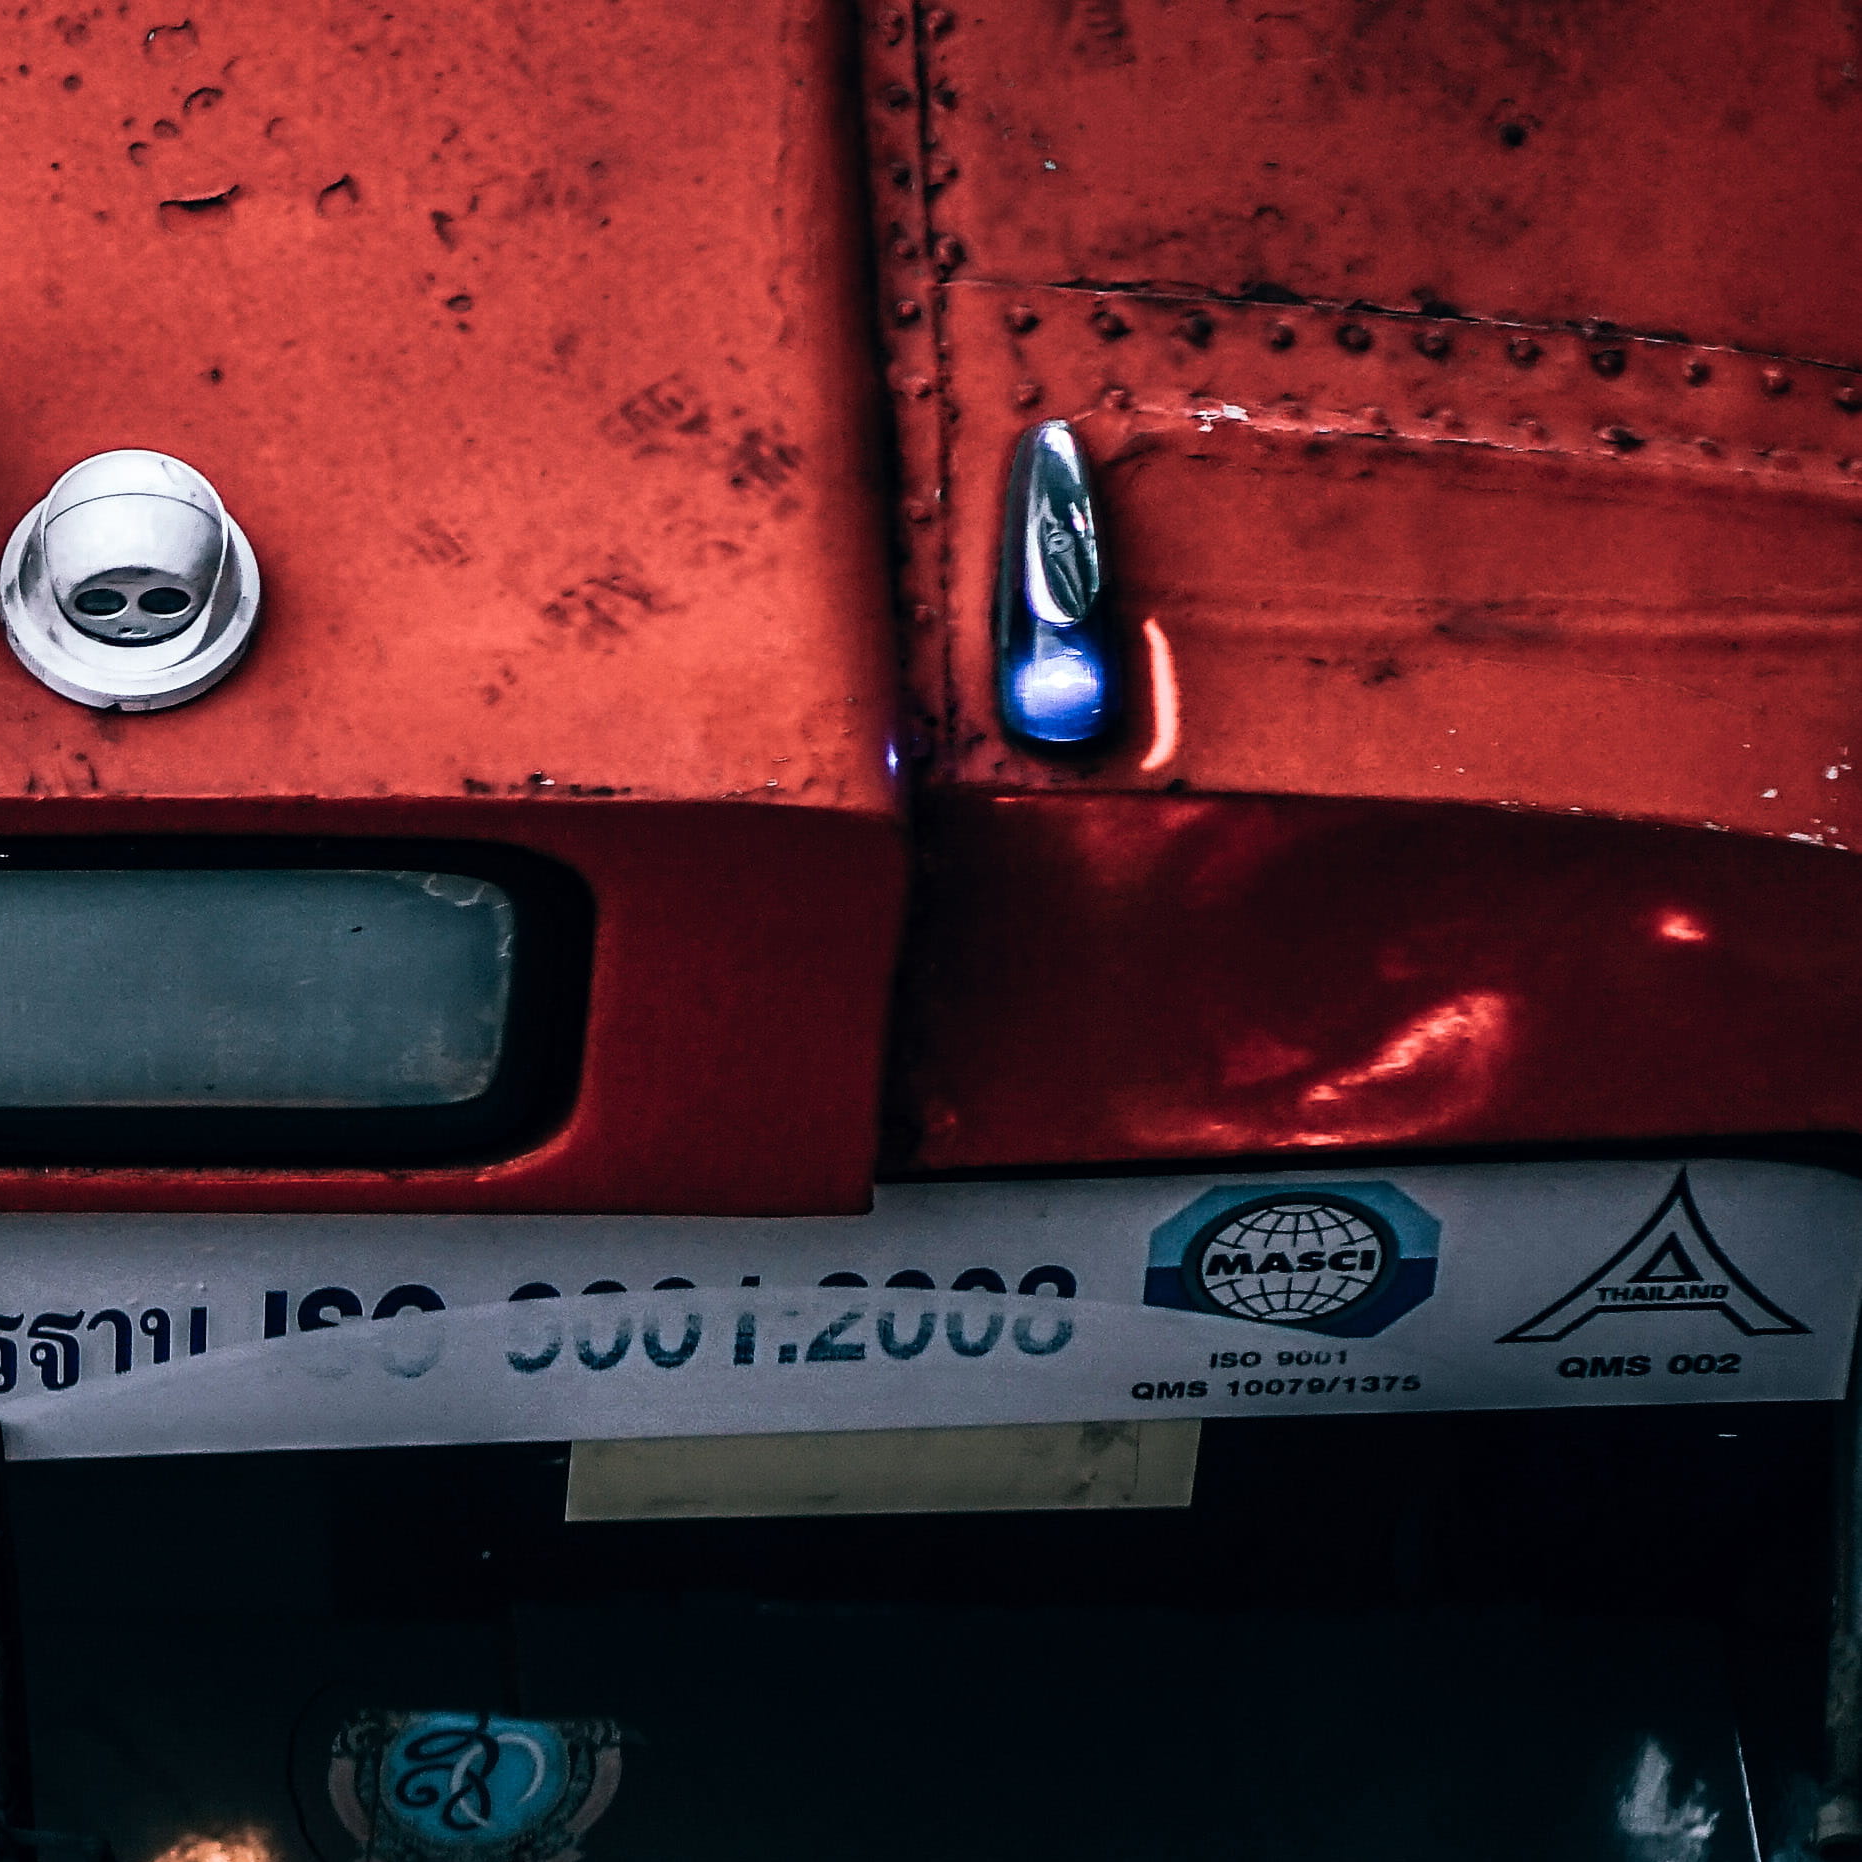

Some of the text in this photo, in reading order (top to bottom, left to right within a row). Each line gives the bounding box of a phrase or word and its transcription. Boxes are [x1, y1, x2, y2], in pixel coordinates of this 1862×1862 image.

[1205, 1250, 1379, 1276] MASCI
[1596, 1284, 1728, 1300] THAILAND
[1210, 1350, 1347, 1369] ISO 9001
[1558, 1353, 1742, 1378] QMS 002
[1131, 1381, 1208, 1401] QMS
